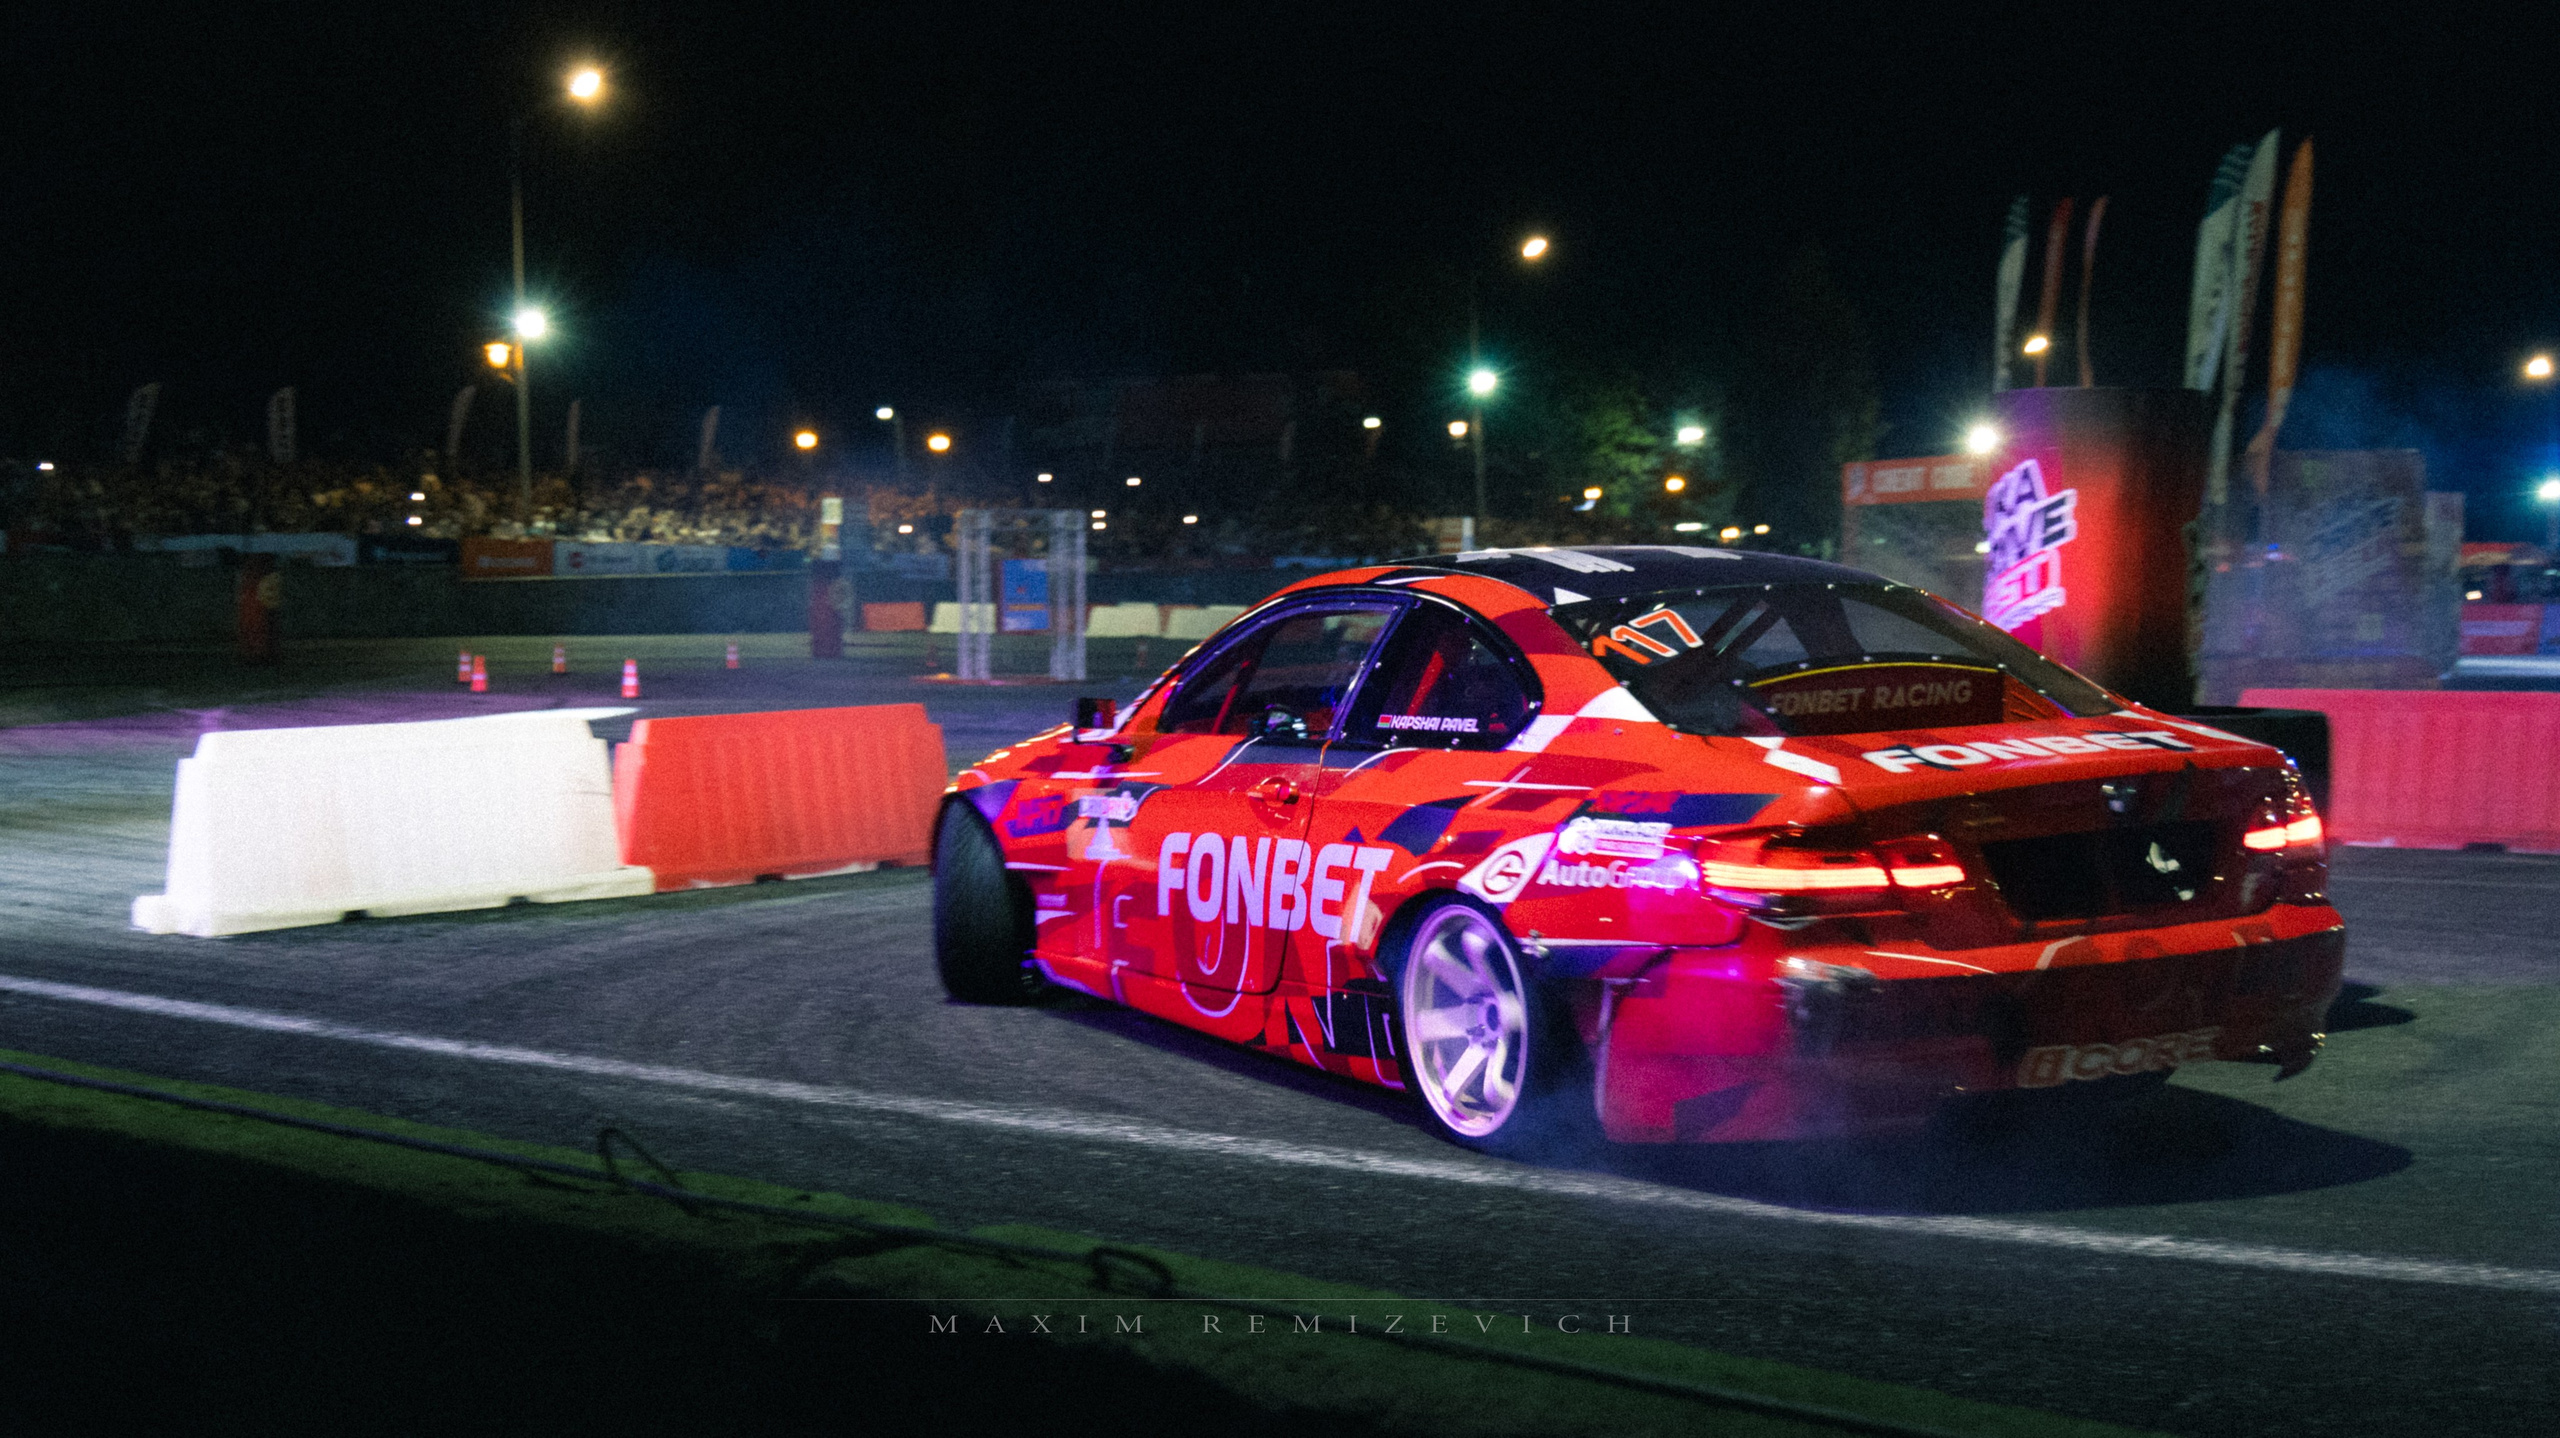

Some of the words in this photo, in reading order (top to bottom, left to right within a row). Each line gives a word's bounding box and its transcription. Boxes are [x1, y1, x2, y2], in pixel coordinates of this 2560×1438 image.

[1592, 609, 1704, 665] 117
[1771, 688, 1866, 716] FONBET
[1873, 680, 1973, 709] RACING
[1391, 715, 1441, 731] KAPSHAI
[1440, 717, 1480, 732] PAVEL
[1861, 731, 2190, 773] FONBET
[1157, 831, 1395, 944] FONBET
